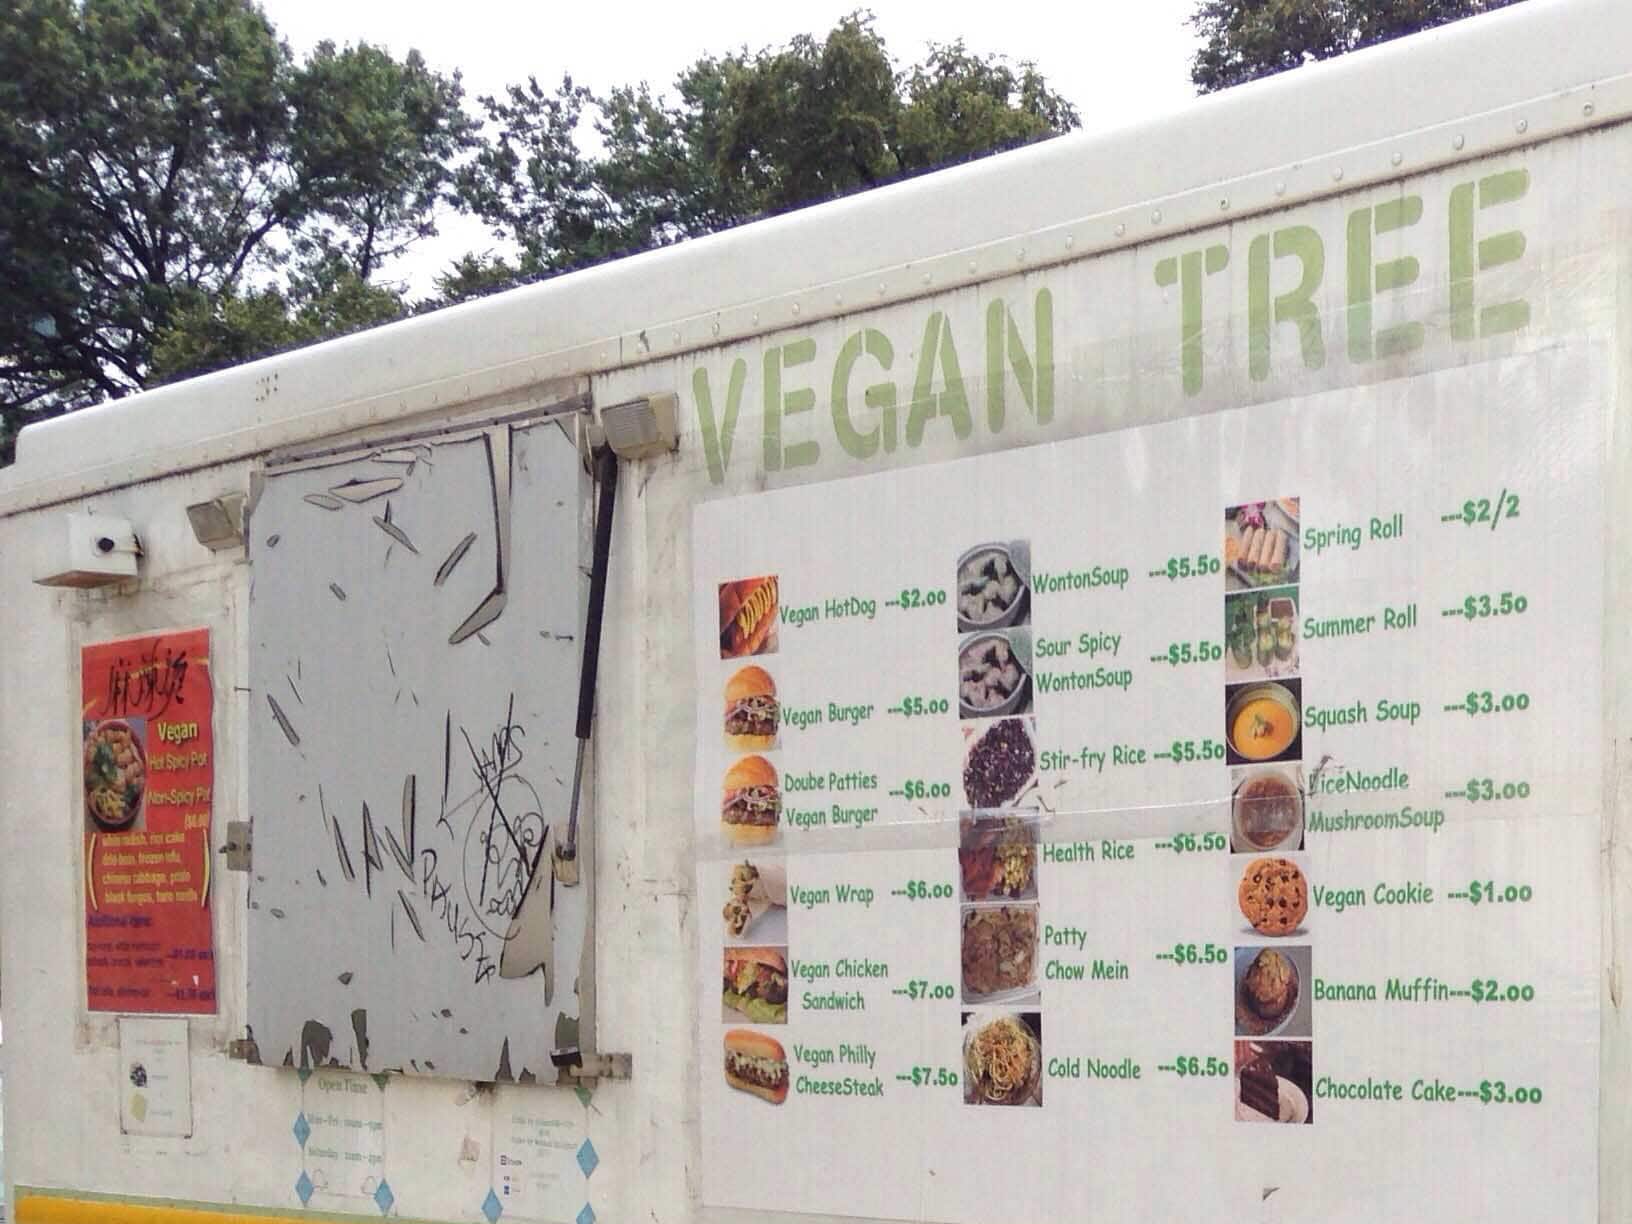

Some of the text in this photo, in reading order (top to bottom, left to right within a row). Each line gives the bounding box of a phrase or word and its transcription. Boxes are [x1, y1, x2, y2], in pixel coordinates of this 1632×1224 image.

[693, 168, 1531, 485] VEGAN TREE
[1303, 524, 1362, 555] Spring
[1367, 513, 1402, 540] Roll
[1031, 566, 1129, 594] WontonSoup
[780, 602, 819, 628] Vegan
[823, 597, 876, 619] HotDog
[1303, 616, 1376, 639] Summer
[1382, 604, 1416, 630] Roll
[1035, 638, 1071, 658] Sour
[1077, 632, 1121, 659] Spicy
[1035, 666, 1132, 693] WontonSoup
[783, 708, 822, 730] Vegan
[827, 702, 874, 726] Burger
[1304, 700, 1367, 733] Squash
[1376, 699, 1420, 726] Soup
[158, 722, 198, 744] Vegan
[1040, 747, 1105, 773] Stir-fry
[1111, 745, 1146, 765] Rice
[784, 772, 826, 792] Doube
[827, 770, 877, 791] Patties
[785, 805, 878, 829] Vegan Burger
[1308, 806, 1444, 832] MushroomSoup
[1041, 841, 1094, 862] Health
[1100, 840, 1134, 860] Rice
[790, 886, 831, 909] Vegan
[834, 884, 874, 908] Wrap
[1312, 885, 1365, 913] Vegan
[1372, 881, 1433, 904] Cookie
[1043, 924, 1087, 951] Patty
[791, 960, 829, 982] Vegan
[835, 958, 888, 978] Chicken
[1045, 960, 1085, 980] Chow
[1090, 960, 1128, 980] Mein
[800, 992, 864, 1010] Sandwich
[1312, 976, 1376, 1000] Banana
[1382, 976, 1449, 1002] Muffin
[793, 1045, 834, 1068] Vegan
[838, 1043, 876, 1069] Philly
[1048, 1057, 1081, 1078] Cold
[1085, 1057, 1141, 1079] Noodle
[795, 1076, 883, 1096] CheeseSteak
[1313, 1076, 1403, 1100] Chocolate
[1408, 1077, 1457, 1102] Cake
